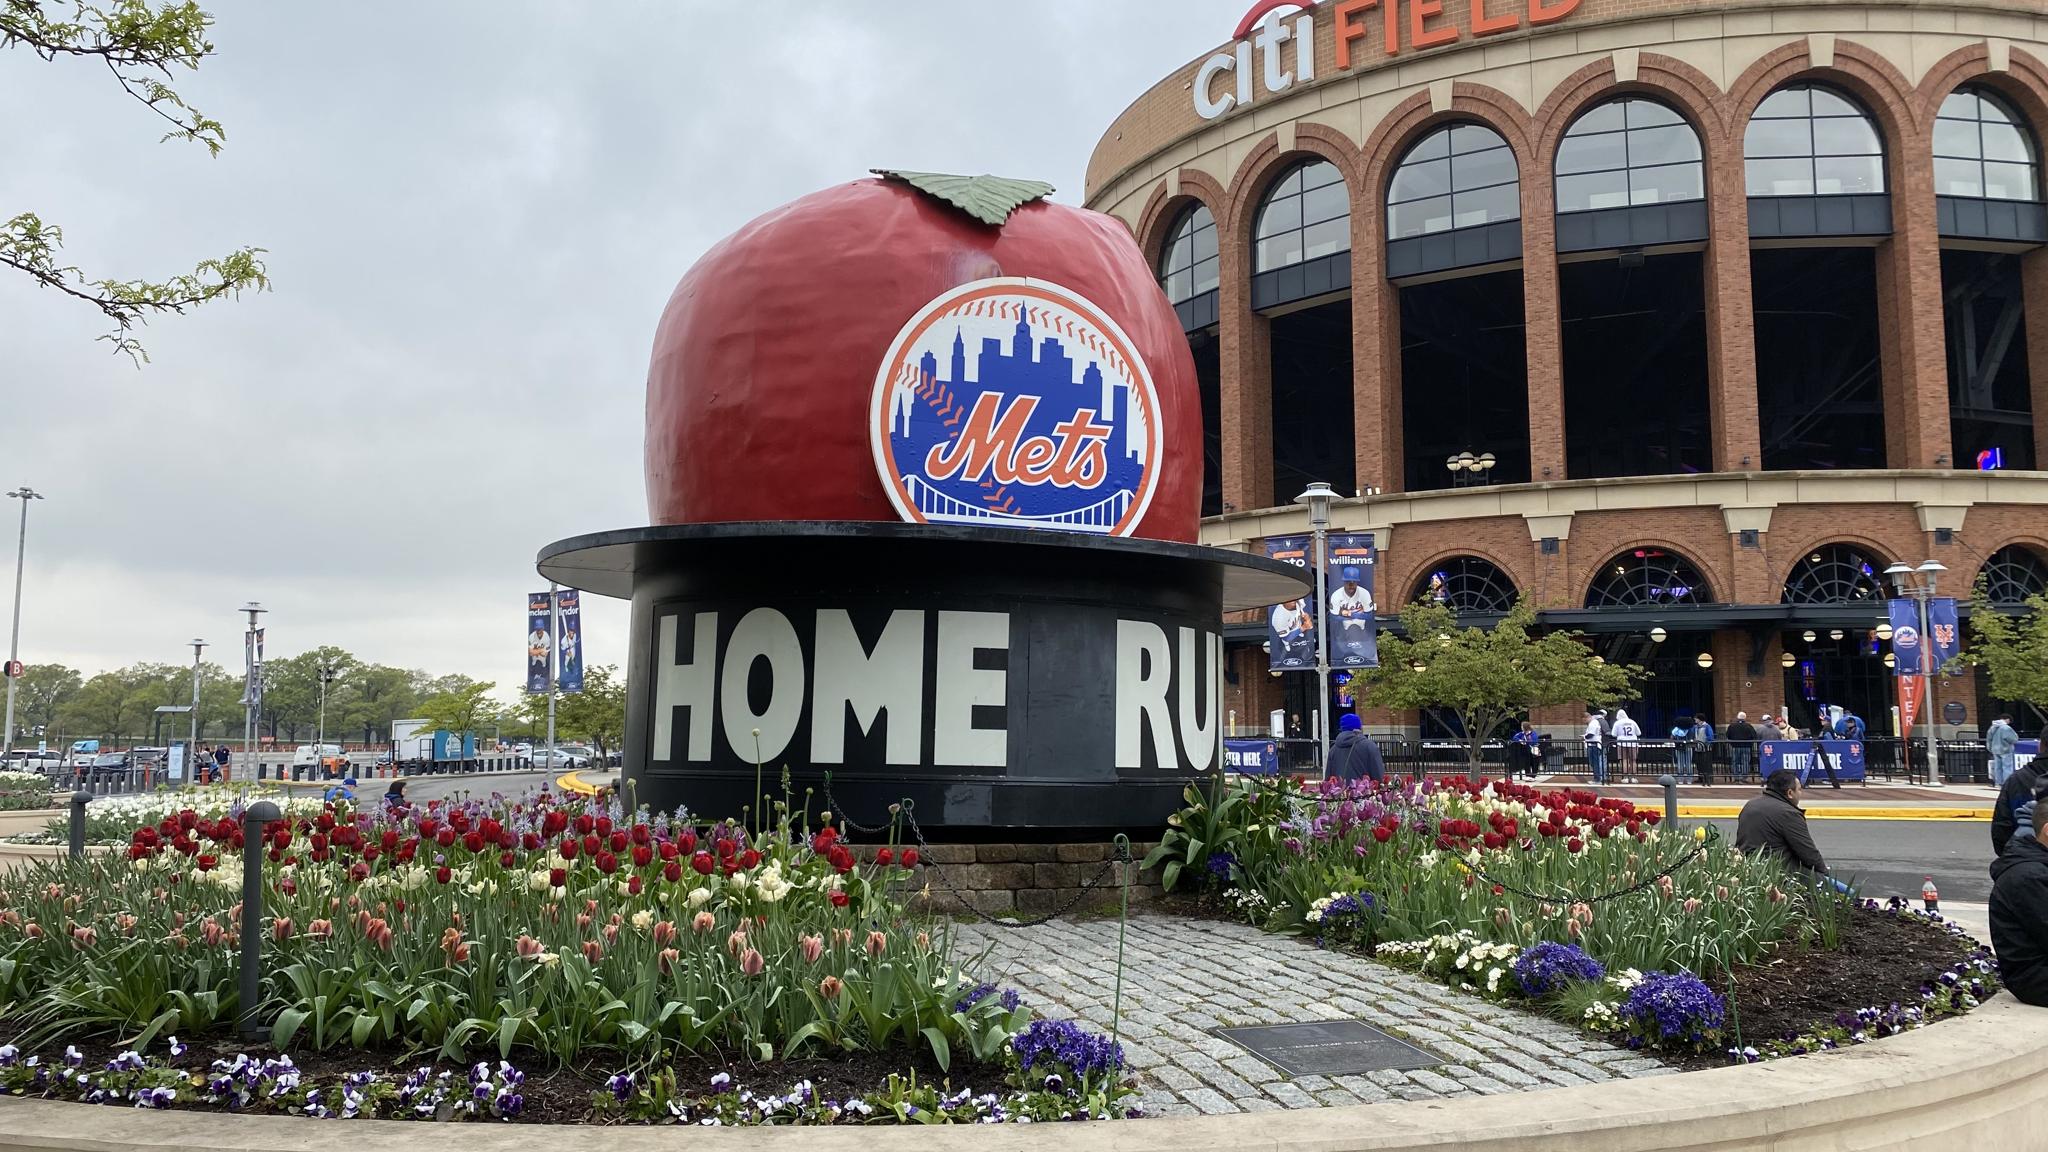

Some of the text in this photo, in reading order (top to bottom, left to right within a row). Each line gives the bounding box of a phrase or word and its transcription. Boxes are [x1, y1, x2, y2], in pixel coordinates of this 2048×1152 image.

[1194, 11, 1315, 120] citi
[924, 390, 1113, 490] Mets
[1282, 557, 1305, 568] to
[1329, 556, 1374, 565] williams
[559, 606, 579, 616] lindor
[14, 662, 21, 674] B
[653, 607, 1224, 772] HOME RU
[1902, 676, 1914, 726] NTER
[1623, 726, 1633, 736] 12
[1225, 752, 1261, 766] TER HERE
[1783, 753, 1842, 769] ENTE HRE
